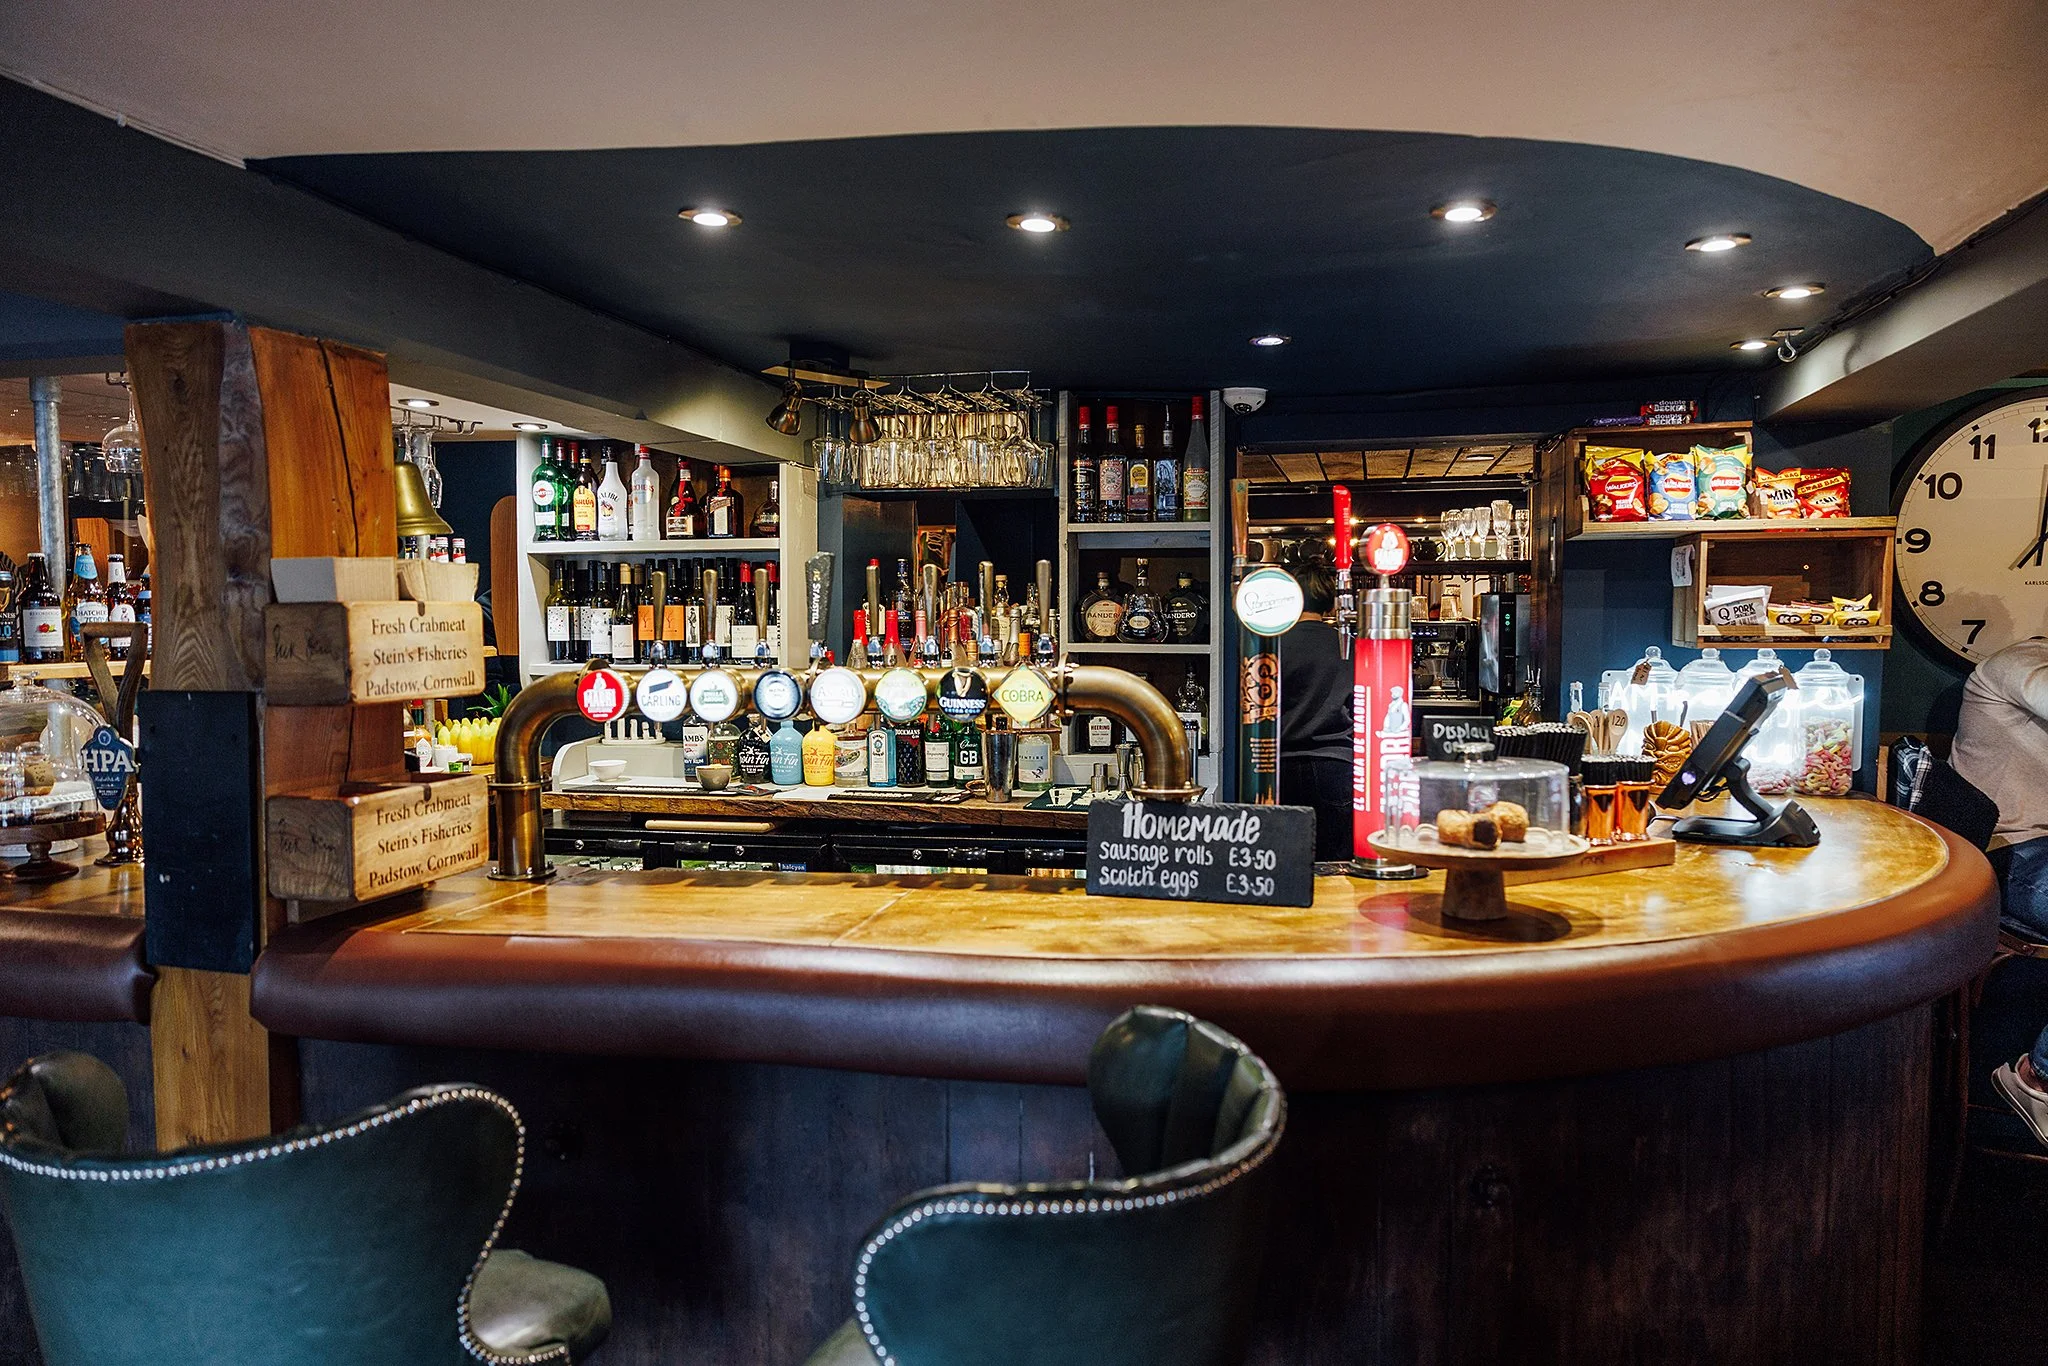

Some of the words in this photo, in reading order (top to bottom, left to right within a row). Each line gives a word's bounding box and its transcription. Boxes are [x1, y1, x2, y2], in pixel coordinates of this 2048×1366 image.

[1653, 404, 1687, 412] DECKER
[1649, 418, 1683, 426] DECKER
[1968, 433, 1997, 460] 11
[1606, 481, 1637, 491] WALKERS
[1801, 482, 1824, 493] GRAB
[1824, 477, 1841, 488] BAG
[1924, 472, 1963, 501] 10
[1904, 527, 1932, 554] 9
[1919, 580, 1945, 607] 8
[1718, 607, 1730, 621] Q
[1733, 602, 1755, 615] PORK
[371, 617, 406, 634] Fresh
[409, 616, 466, 633] Crabmeat
[1779, 614, 1801, 625] KP
[1961, 619, 1987, 645] 7
[373, 648, 415, 666] Stein's
[417, 646, 468, 662] Fisheries
[423, 669, 475, 690] Cornwall
[641, 694, 681, 707] CARLING
[939, 696, 986, 709] GUINNESS
[1002, 689, 1045, 703] COBRA
[1354, 685, 1366, 733] MADRID
[1612, 715, 1626, 727] 120
[1353, 738, 1365, 753] DE
[82, 748, 134, 772] HPA
[755, 751, 770, 765] Fin
[783, 752, 799, 766] Fin
[960, 750, 978, 764] GB
[1353, 758, 1365, 792] ALMA
[376, 806, 411, 826] Fresh
[415, 793, 472, 816] Crabmeat
[1353, 796, 1365, 811] EL
[377, 834, 419, 856] Stein's
[420, 822, 473, 846] Fisheries
[427, 843, 480, 873] Cornwall
[1174, 845, 1214, 866] rolls
[1160, 869, 1200, 897] eggs
